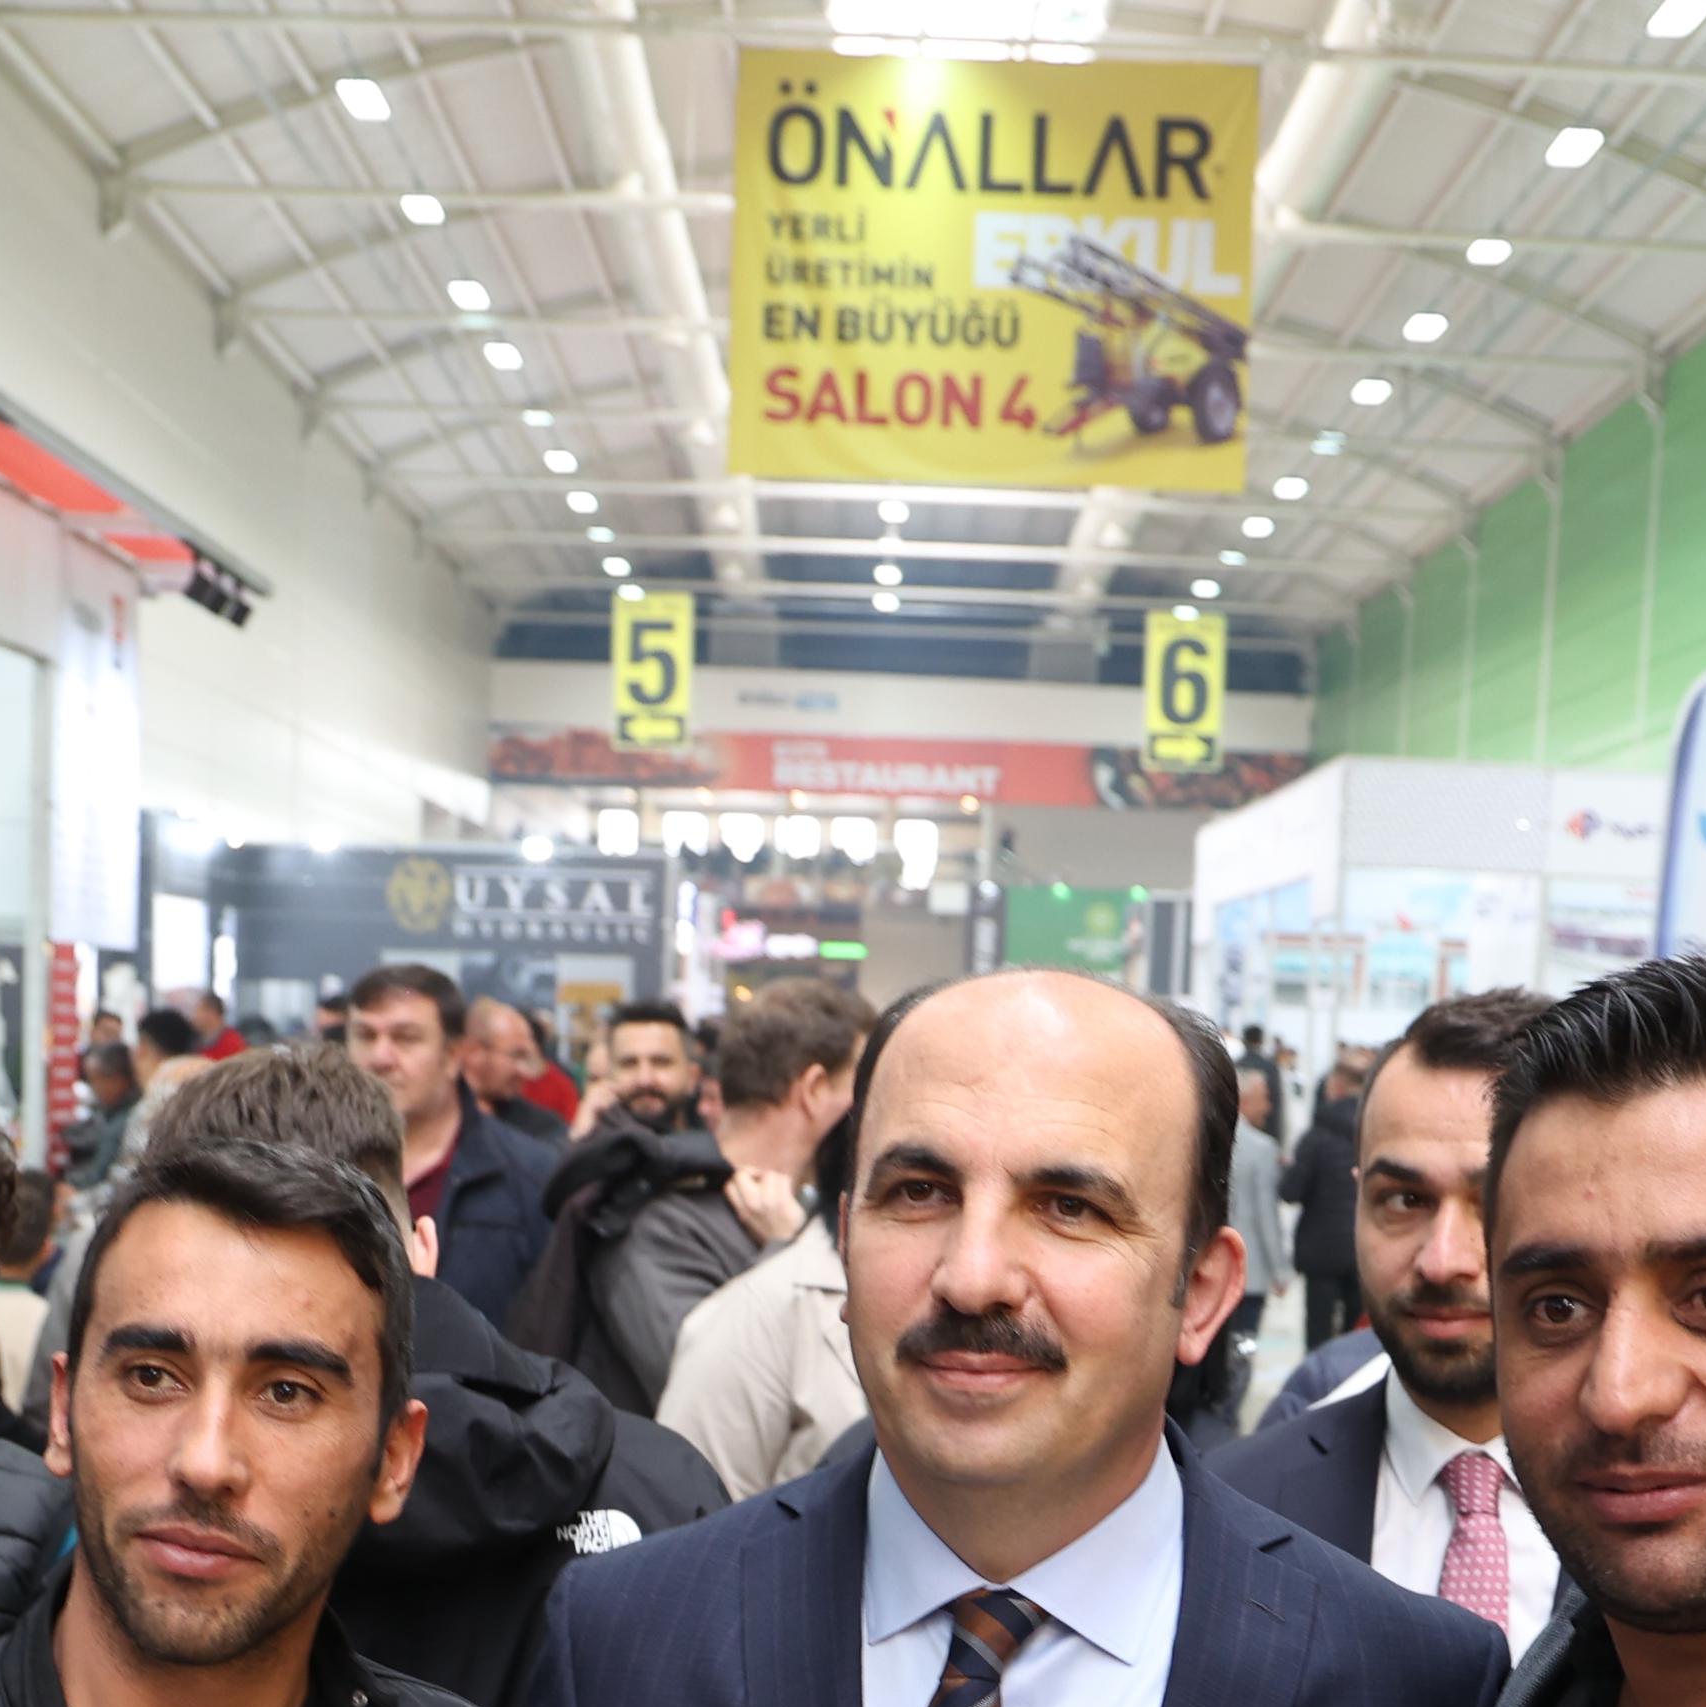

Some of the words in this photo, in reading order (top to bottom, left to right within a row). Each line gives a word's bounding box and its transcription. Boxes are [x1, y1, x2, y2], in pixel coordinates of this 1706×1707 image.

[767, 79, 1213, 201] ÖNALLAR
[768, 210, 866, 244] YERLİ
[765, 251, 935, 288] ÜRETİMİN
[762, 304, 822, 342] EN
[837, 301, 1021, 348] BÜYÜĞÜ
[763, 367, 983, 429] SALON
[1000, 373, 1037, 430] 4
[625, 619, 678, 706] 5
[1159, 638, 1209, 726] 6
